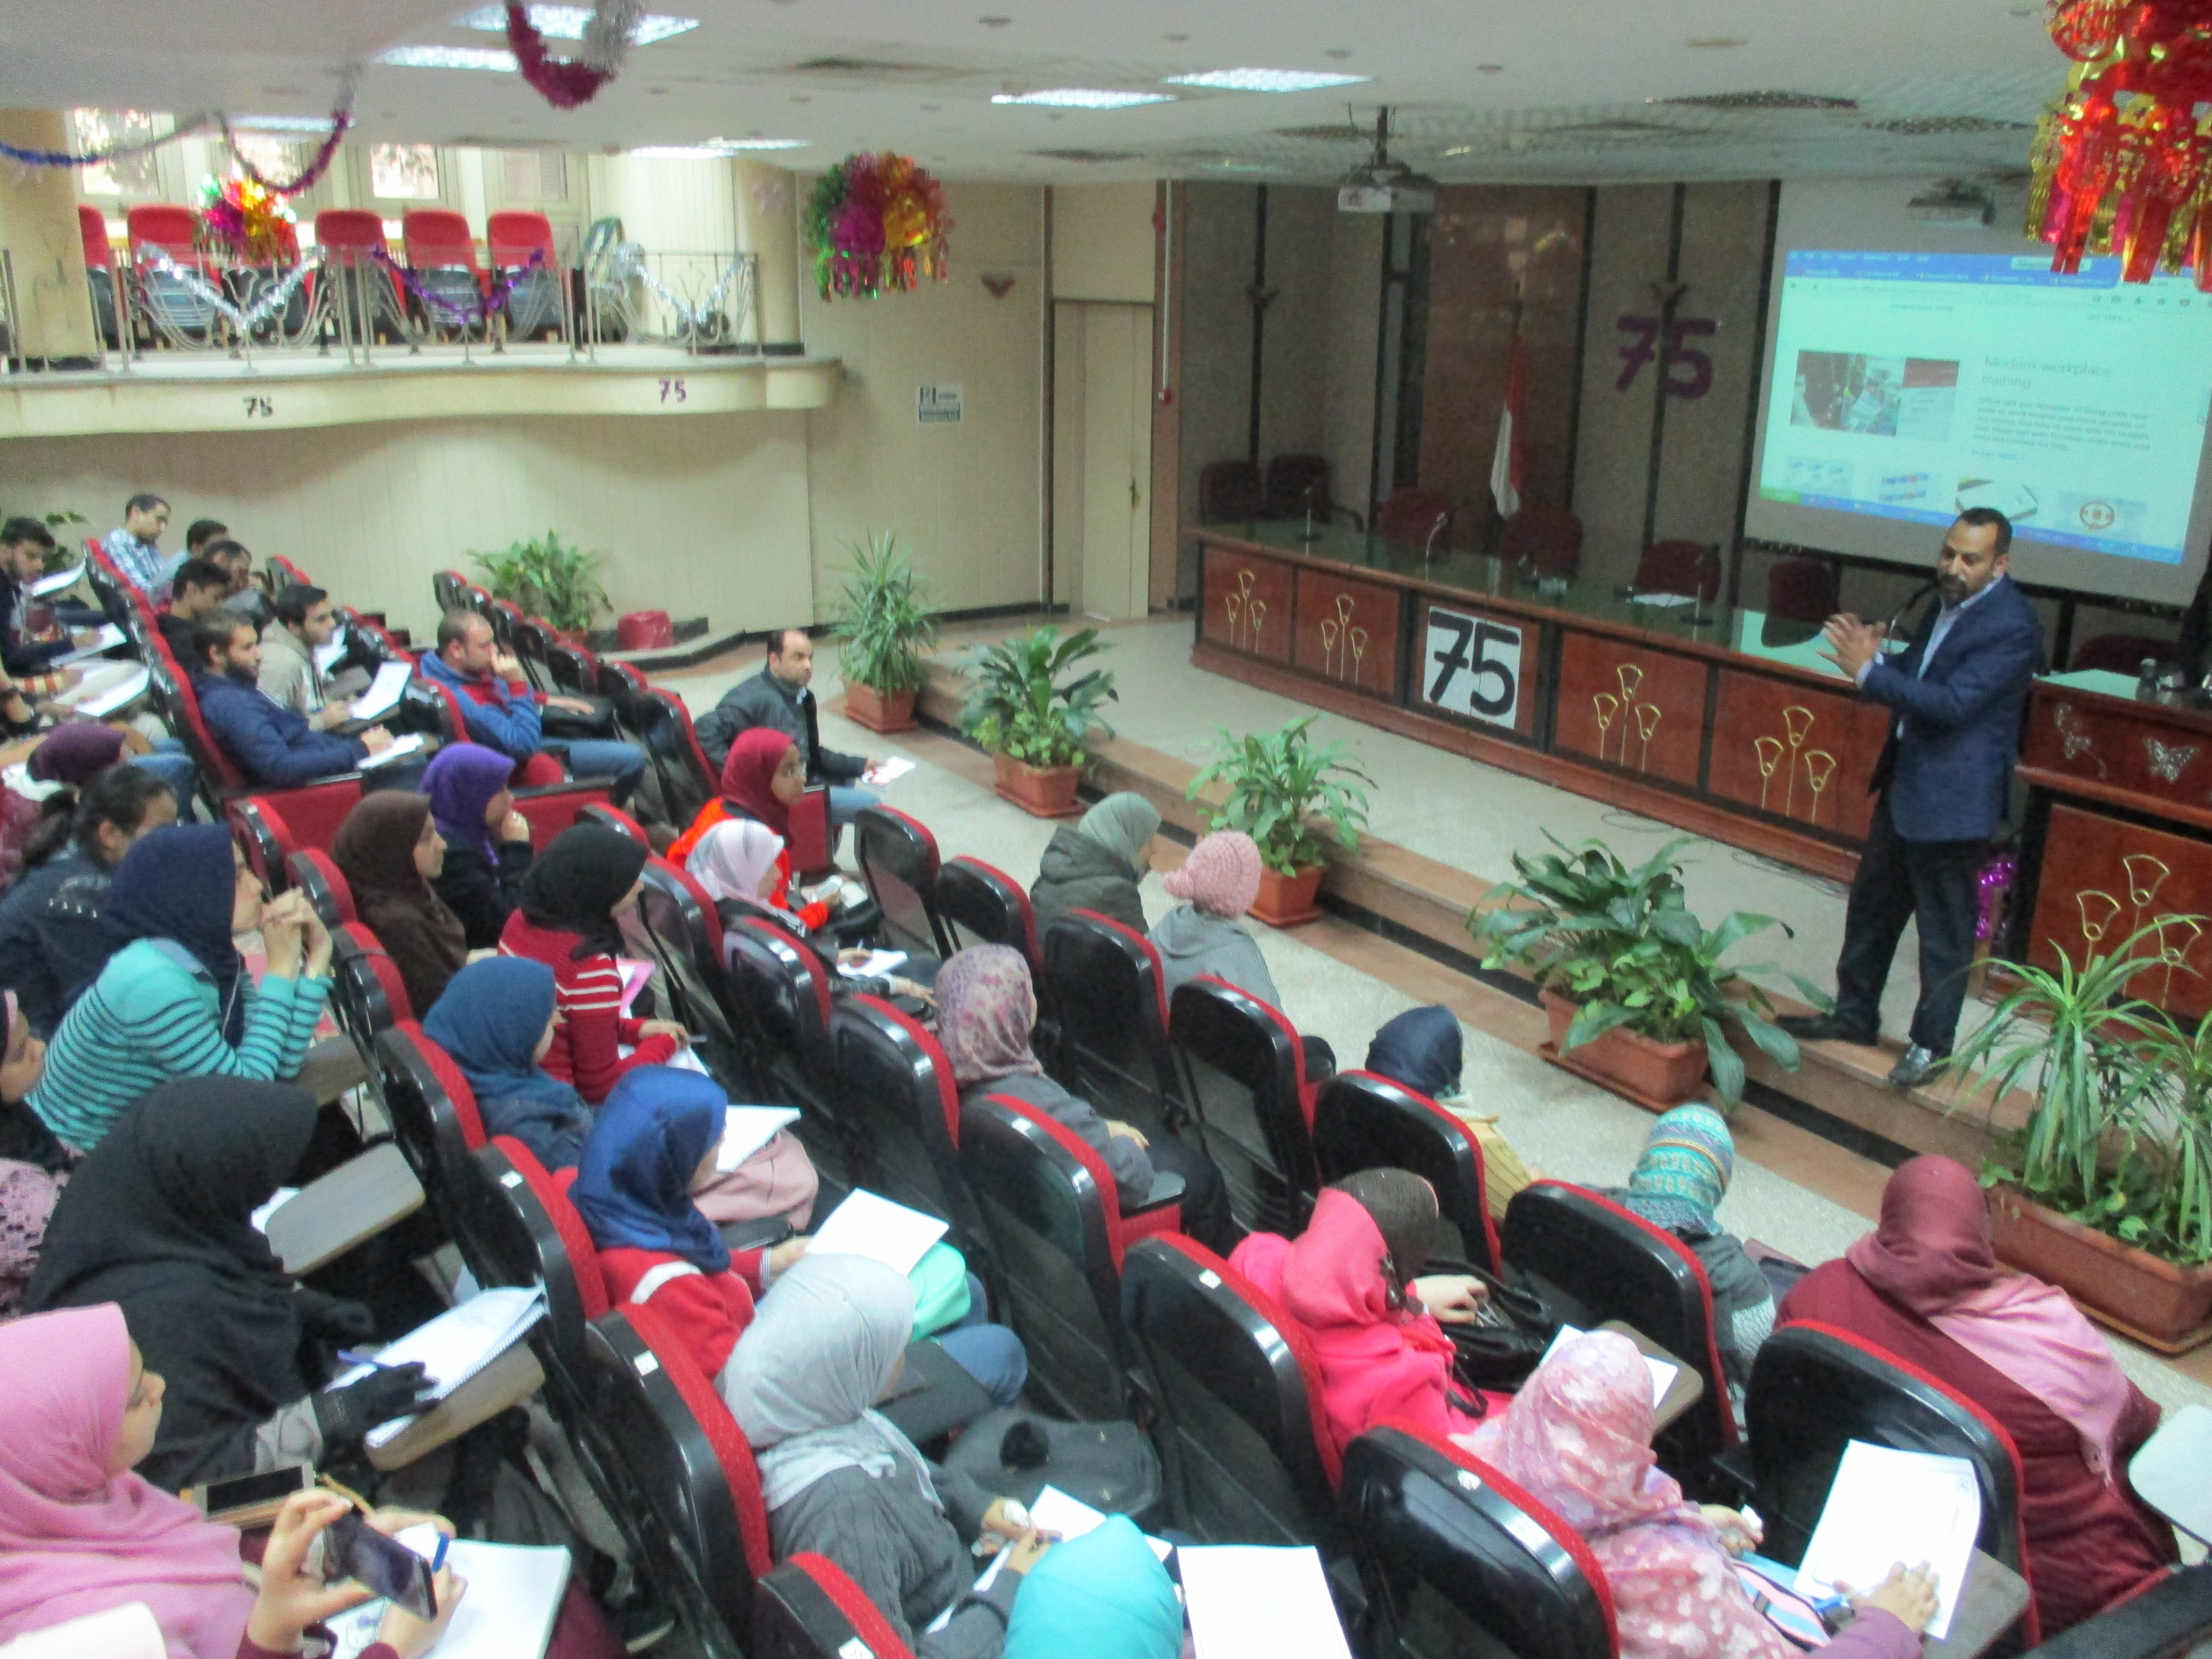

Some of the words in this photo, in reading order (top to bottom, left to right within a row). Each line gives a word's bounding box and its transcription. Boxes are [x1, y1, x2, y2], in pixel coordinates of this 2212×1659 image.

[1616, 316, 1716, 399] 75
[1984, 355, 2037, 371] Modern
[659, 378, 686, 404] 75
[1429, 610, 1521, 716] 75
